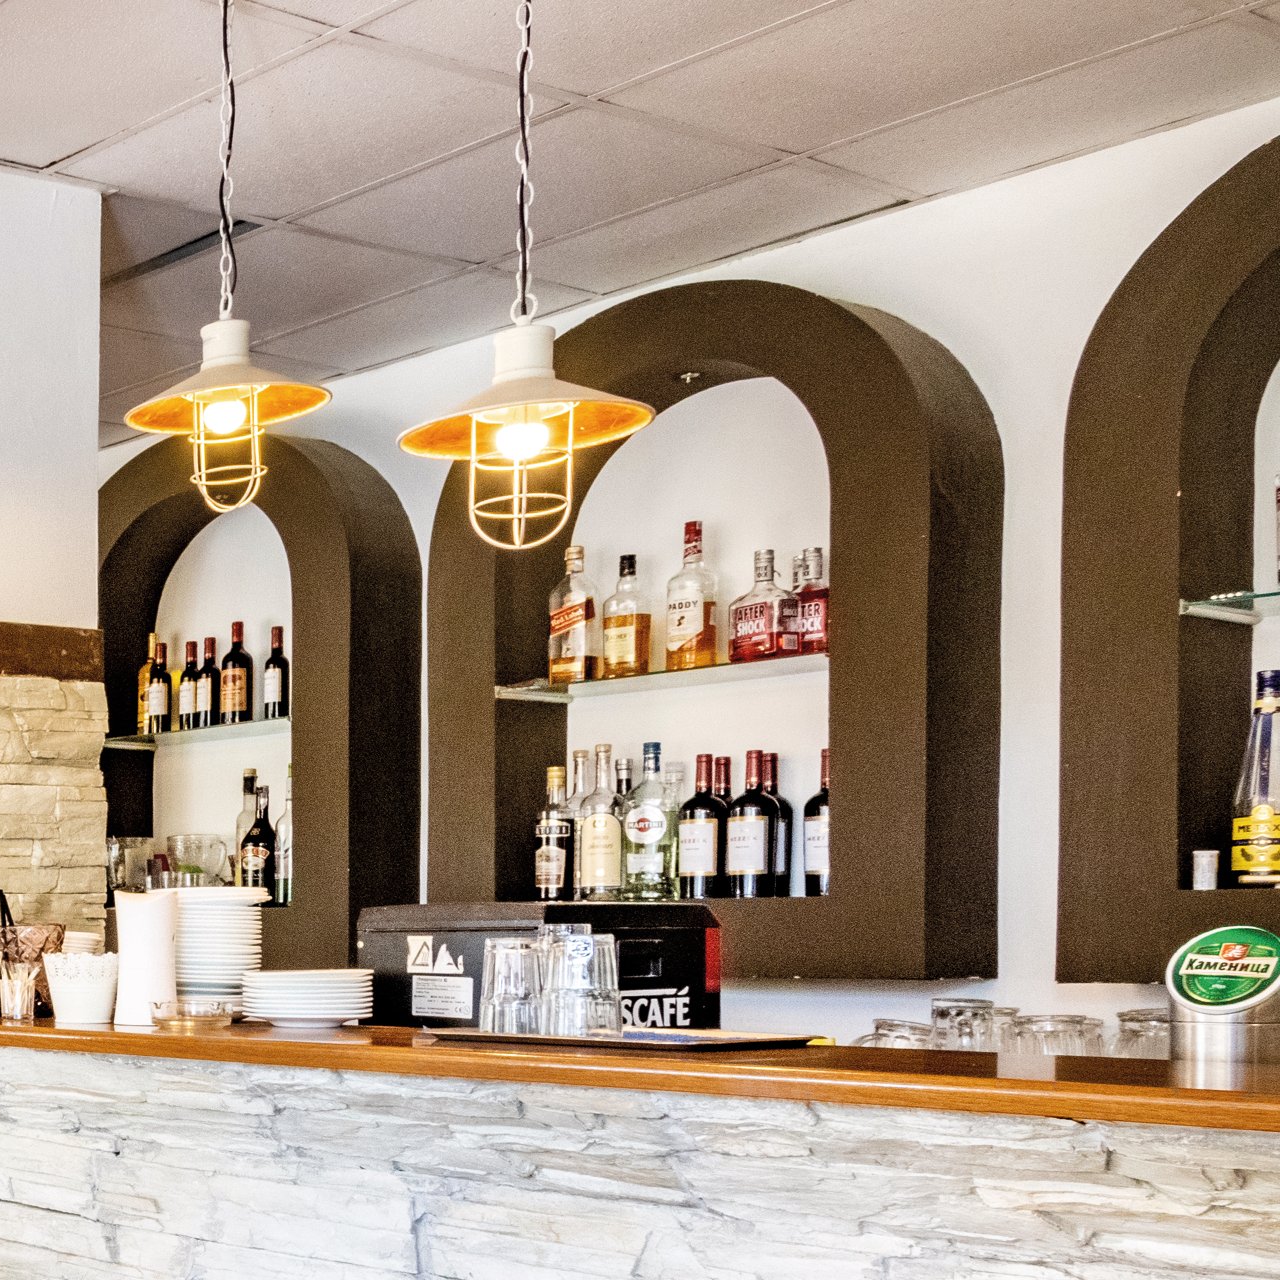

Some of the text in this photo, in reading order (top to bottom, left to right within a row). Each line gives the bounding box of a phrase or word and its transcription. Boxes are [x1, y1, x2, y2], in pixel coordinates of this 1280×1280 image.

[668, 600, 699, 611] PADDY
[737, 605, 765, 621] AFTER
[801, 602, 821, 617] TER
[550, 607, 583, 627] Red Label
[737, 620, 766, 636] SHOCK
[536, 825, 568, 835] TINI
[627, 820, 663, 830] MARTINI
[1185, 958, 1270, 974] Каменица
[620, 986, 691, 1028] SCAFÉ
